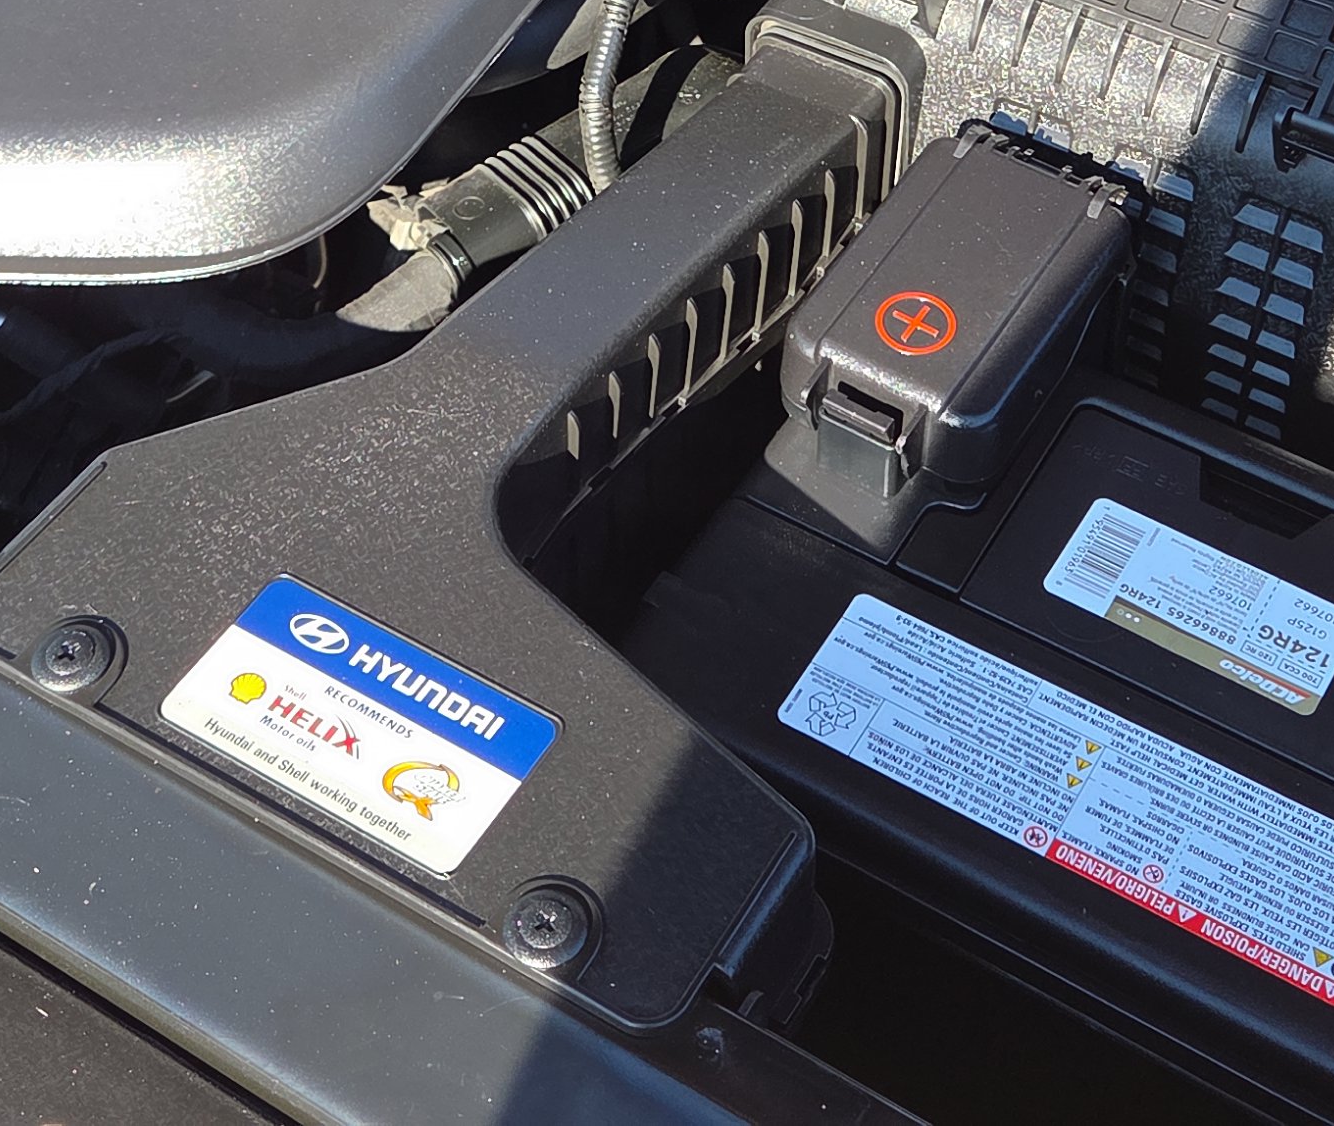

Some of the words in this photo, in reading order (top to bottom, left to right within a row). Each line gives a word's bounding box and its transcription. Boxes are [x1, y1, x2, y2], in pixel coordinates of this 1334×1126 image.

[1118, 583, 1161, 609] 124RG
[1208, 584, 1252, 611] 107662
[1166, 606, 1237, 645] 88866265
[1286, 617, 1327, 640] G125P
[1244, 644, 1257, 654] RC
[1257, 624, 1330, 668] 124RG
[1257, 650, 1272, 662] 120
[1283, 662, 1301, 675] CCA
[1215, 658, 1306, 704] ACDelco
[1301, 671, 1318, 684] 700
[284, 684, 307, 701] Shell
[348, 643, 505, 740] HYUNDAI
[324, 685, 413, 738] RECOMMENDS
[259, 714, 295, 739] Motor
[296, 737, 316, 751] oils
[267, 694, 361, 756] HELIX
[1125, 735, 1139, 746] UN
[1130, 749, 1152, 763] HELP
[1139, 741, 1186, 768] CONSULTER
[1152, 758, 1188, 781] MEDICAL
[204, 717, 255, 751] Hyundai
[253, 748, 279, 765] and
[277, 759, 310, 783] Shell
[310, 778, 358, 813] working
[359, 806, 411, 840] together
[911, 777, 923, 786] OF
[1187, 777, 1205, 789] GET
[922, 782, 951, 801] REACH
[952, 796, 968, 810] THE
[968, 806, 980, 815] OF
[1236, 800, 1259, 817] WITH
[1257, 799, 1282, 816] L'EAU
[979, 811, 998, 824] OUT
[1084, 805, 1112, 823] FUMER
[1145, 810, 1185, 835] CIGARROS
[1175, 809, 1203, 828] SEVERE
[1289, 814, 1312, 831] YEUX
[997, 821, 1020, 836] KEEP
[1111, 818, 1123, 829] DE
[1202, 823, 1213, 833] OR
[1259, 812, 1317, 845] IMMEDIATELY
[1165, 832, 1180, 845] NO
[1213, 829, 1250, 852] BLINDNES
[1313, 826, 1329, 839] LES
[1105, 841, 1143, 864] SMOKING
[1162, 844, 1175, 855] DE
[1249, 846, 1275, 864] CAUSE
[1186, 843, 1239, 875] EXPLOSIVOS
[1274, 859, 1292, 873] CAN
[1124, 863, 1140, 876] NO
[1291, 868, 1314, 884] ACID
[1055, 844, 1176, 915] PELIGRO/VENENO
[1178, 865, 1225, 894] EXPLOSIFS
[1238, 869, 1268, 889] GASES
[1276, 876, 1283, 884] O
[1173, 888, 1203, 909] GASES
[1207, 894, 1219, 905] OR
[1223, 887, 1243, 903] GAZ
[1252, 889, 1283, 910] RENDRE
[1267, 884, 1286, 899] LOS
[1242, 897, 1260, 912] LES
[1282, 905, 1295, 916] OU
[1202, 903, 1250, 933] EXPLOSIVE
[1221, 901, 1265, 929] BLINDNESS
[1311, 906, 1330, 921] LOS
[1284, 919, 1302, 933] LES
[1295, 911, 1330, 934] BLESSER
[1264, 923, 1291, 941] CAUSE
[1274, 940, 1307, 961] SHIELD
[1292, 937, 1310, 952] CAN
[1200, 918, 1324, 992] DANGER/POISON
